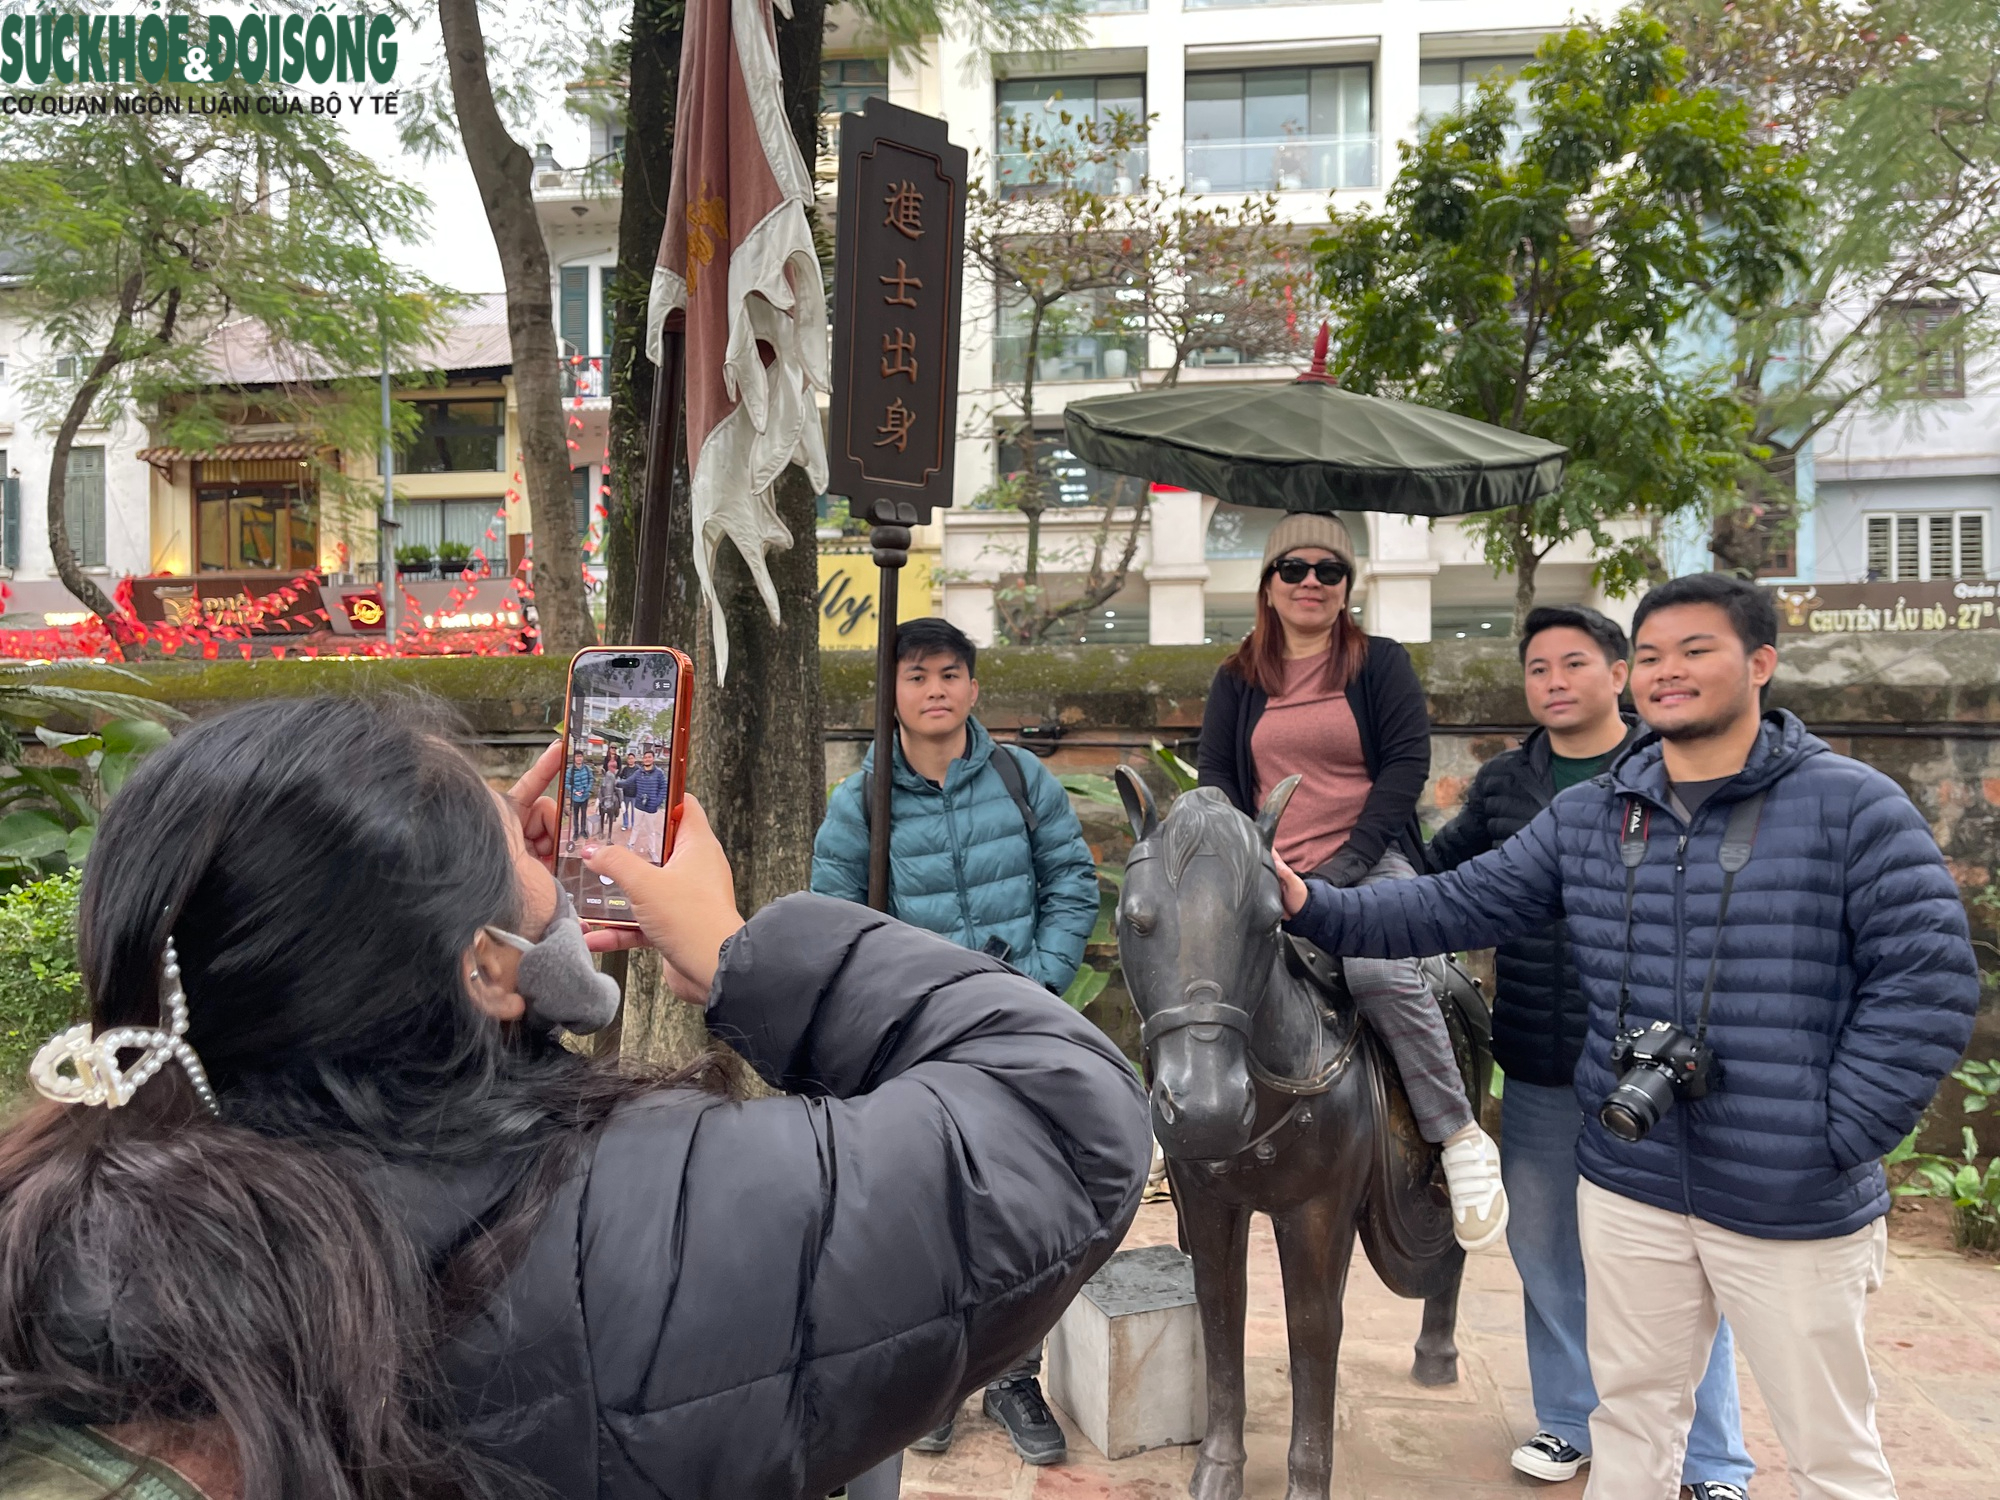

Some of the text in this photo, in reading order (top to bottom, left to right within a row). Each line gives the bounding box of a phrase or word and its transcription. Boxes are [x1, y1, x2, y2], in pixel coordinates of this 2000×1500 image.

[873, 179, 925, 453] 進士出身
[1809, 603, 1881, 632] CHUYÊN
